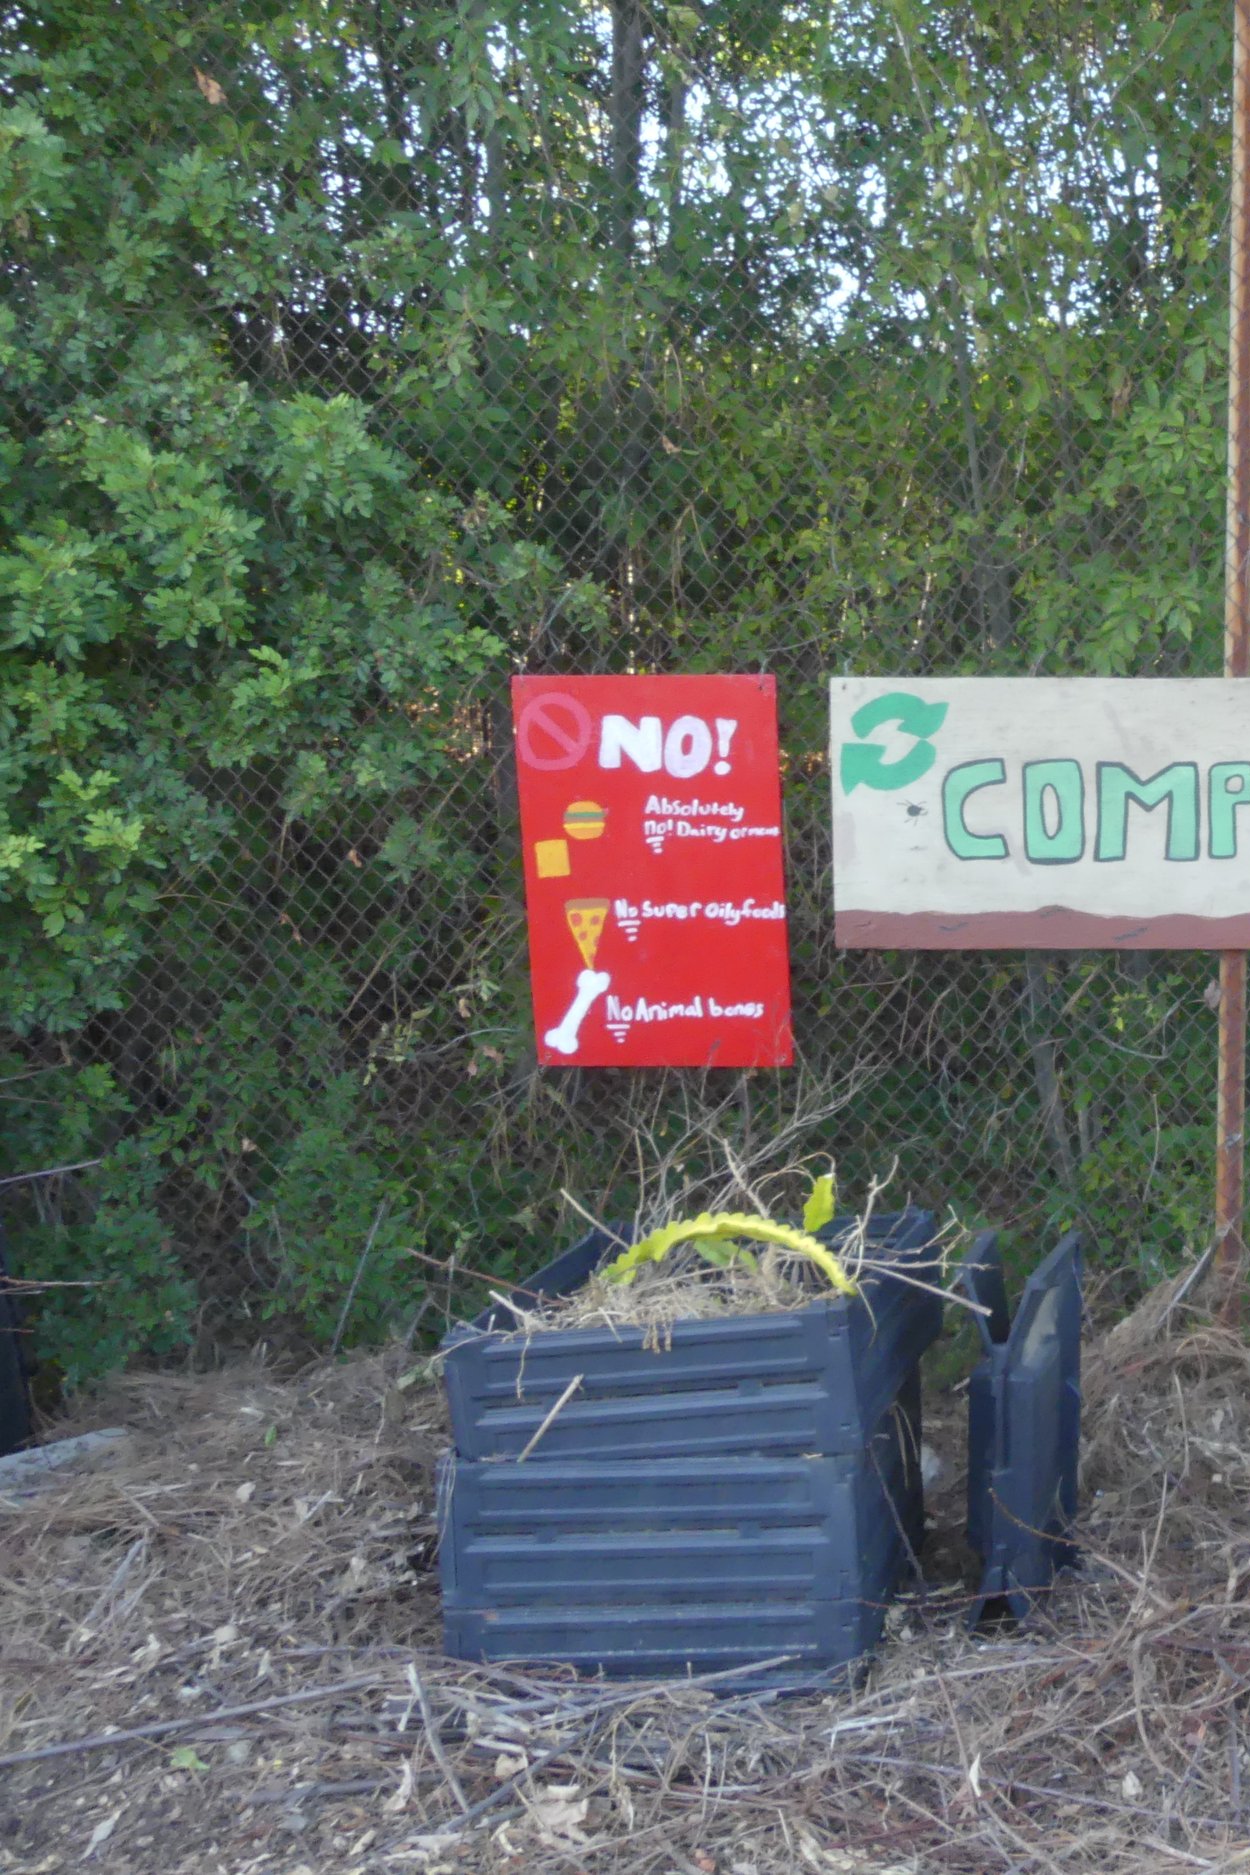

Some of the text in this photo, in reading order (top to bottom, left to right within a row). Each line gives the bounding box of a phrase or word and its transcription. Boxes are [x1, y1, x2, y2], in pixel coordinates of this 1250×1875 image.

[598, 714, 739, 779] NO!
[644, 794, 744, 823] Absolutely
[614, 899, 639, 919] No
[606, 994, 633, 1022] No
[635, 994, 703, 1023] Animal
